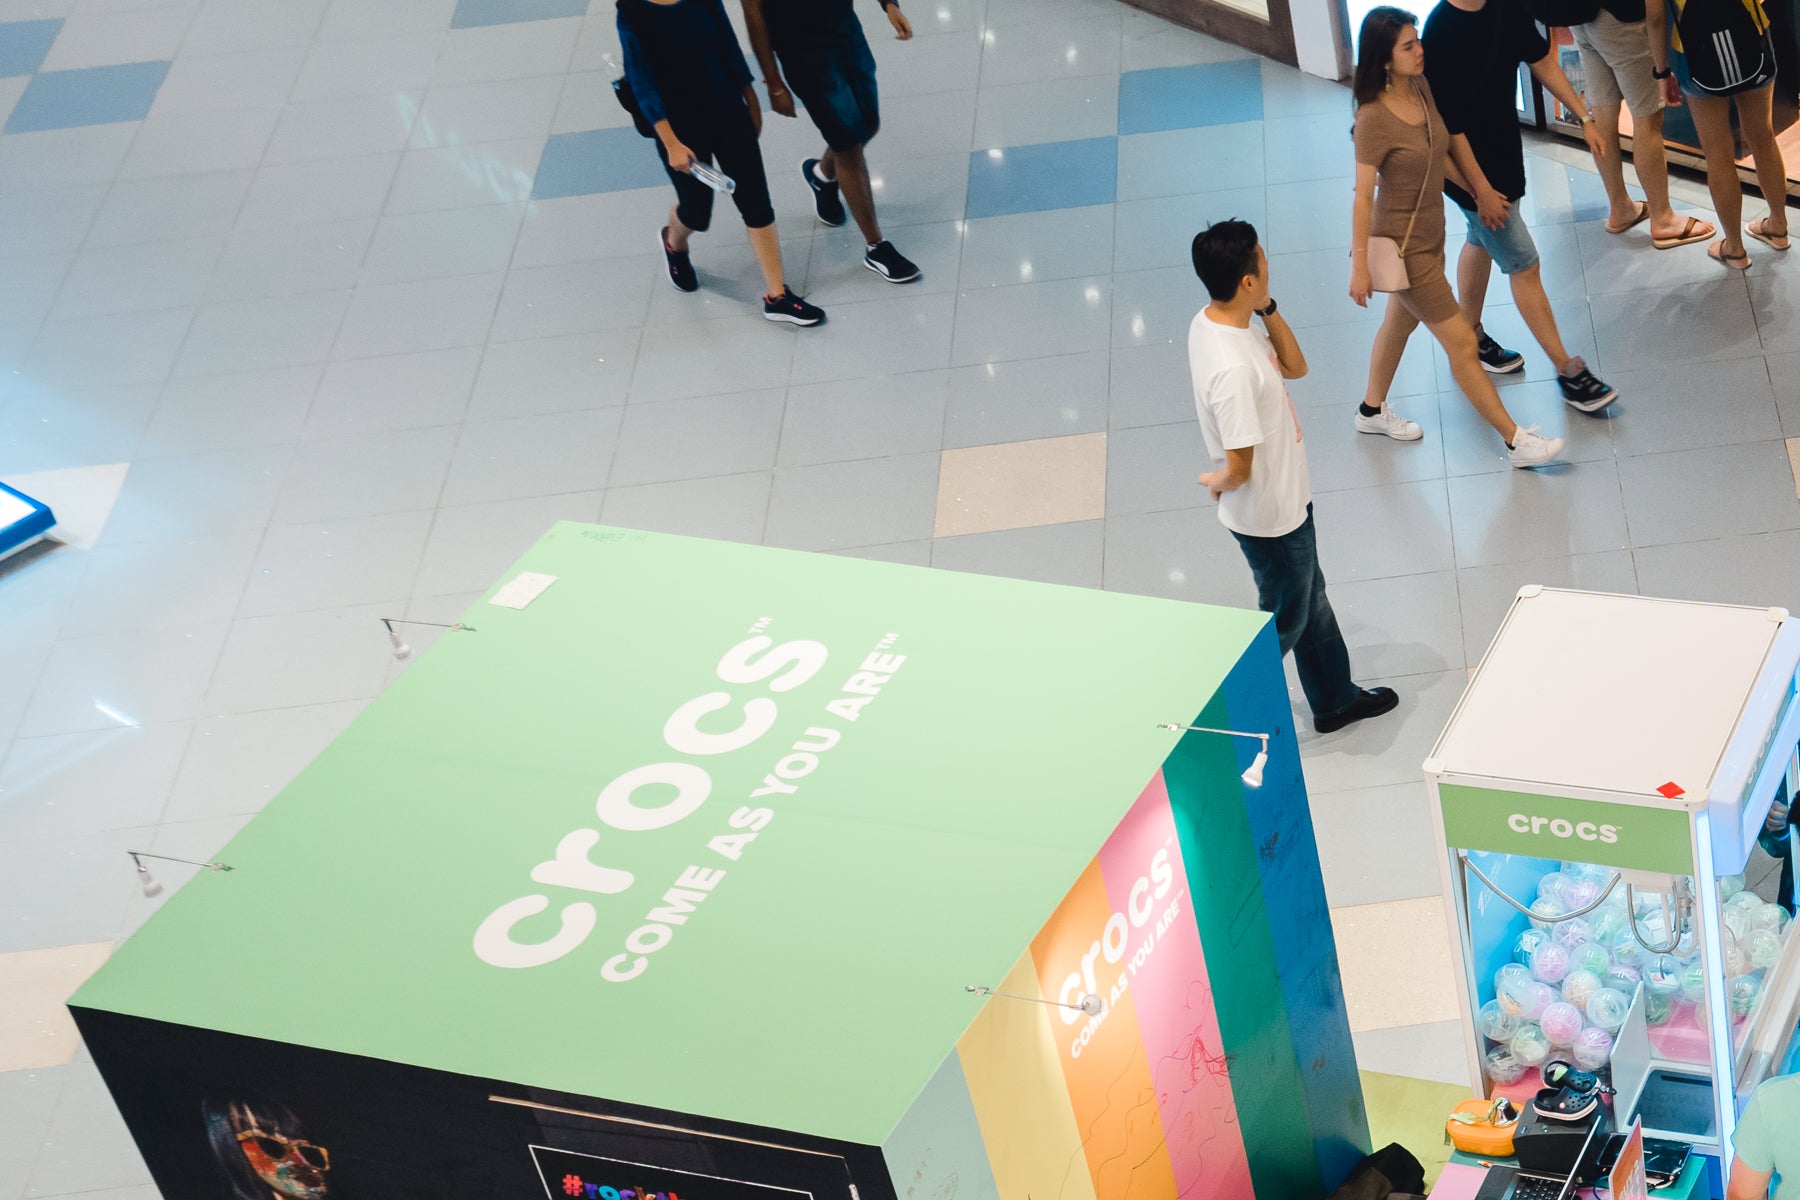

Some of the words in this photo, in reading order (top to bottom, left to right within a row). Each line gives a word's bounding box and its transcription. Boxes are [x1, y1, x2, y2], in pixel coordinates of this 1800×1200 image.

[600, 865, 728, 983] COME
[706, 805, 775, 862] AS
[748, 726, 842, 796] YOU
[1110, 972, 1129, 1008] AS
[1127, 935, 1154, 977] YOU
